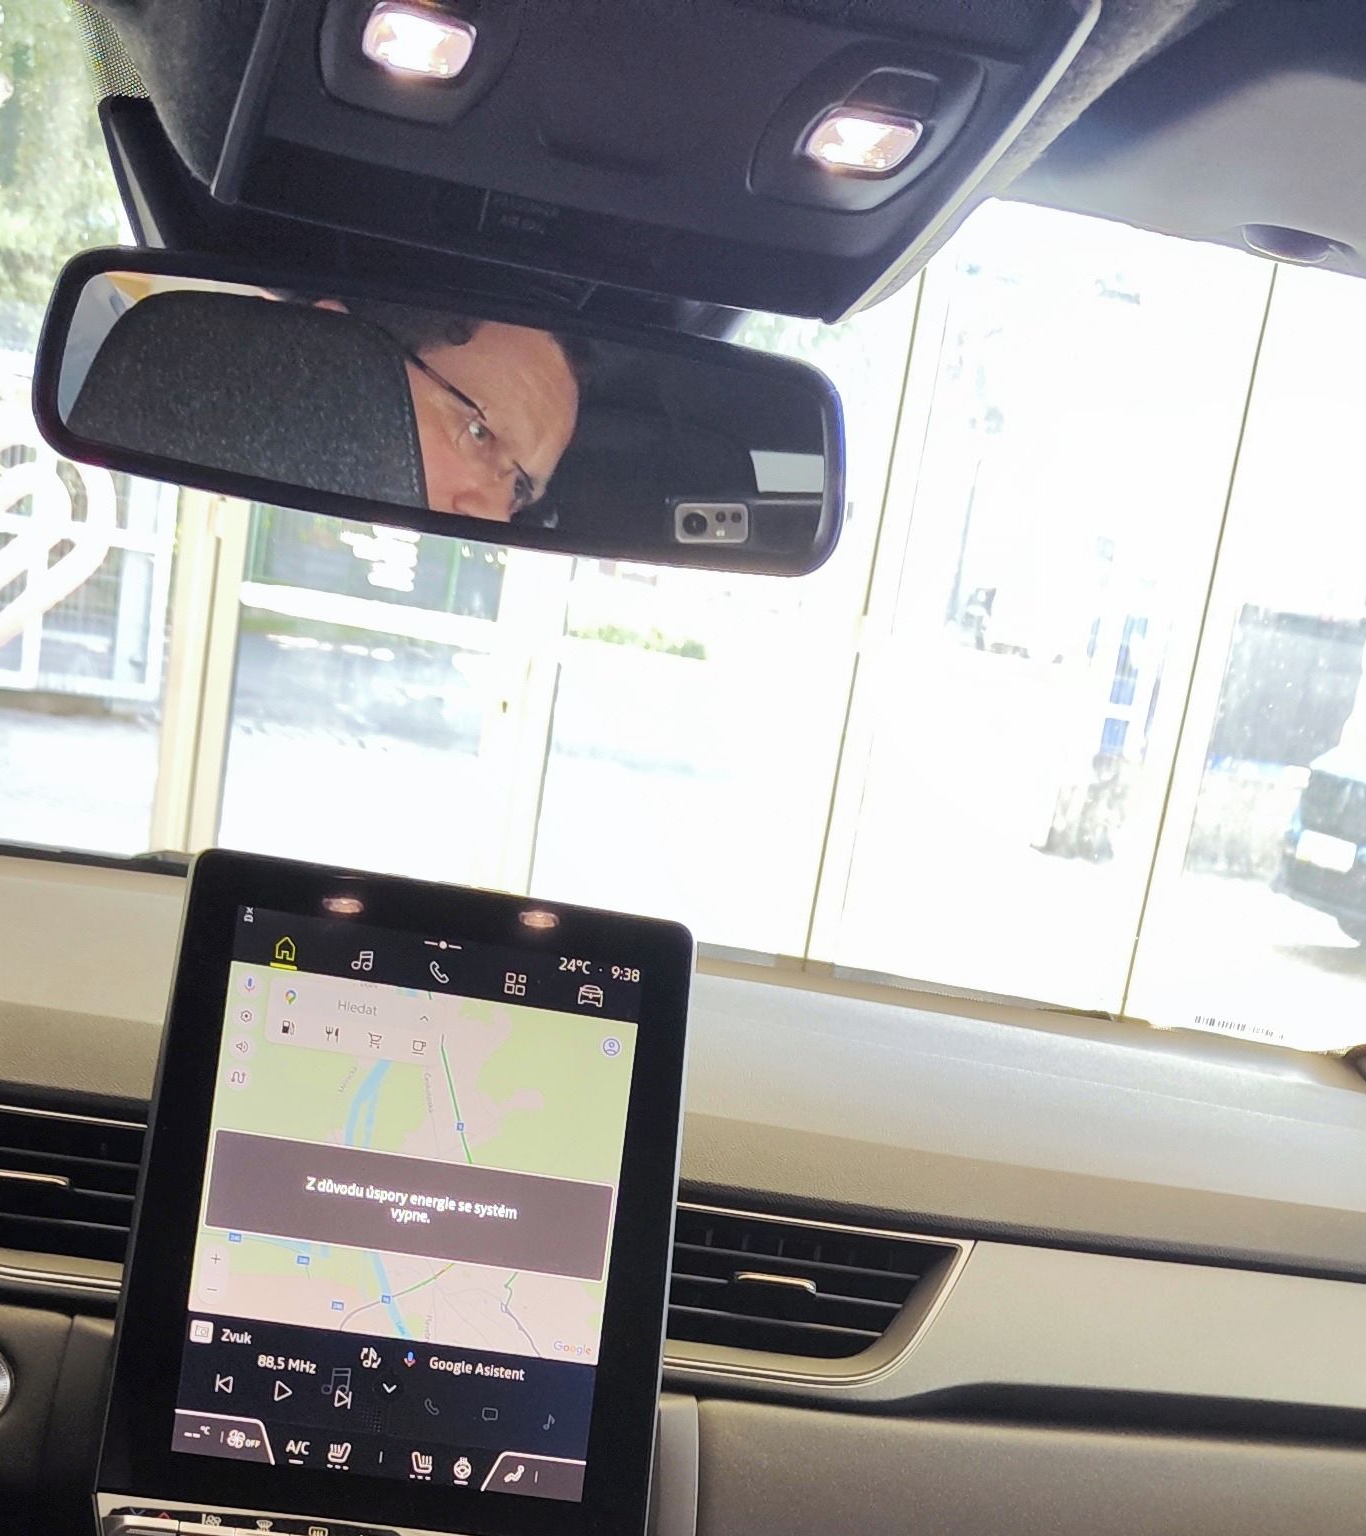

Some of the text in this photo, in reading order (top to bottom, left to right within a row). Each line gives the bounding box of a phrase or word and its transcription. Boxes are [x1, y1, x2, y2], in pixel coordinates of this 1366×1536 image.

[558, 957, 640, 982] 24°C 9:38
[337, 1000, 378, 1016] Hledat
[305, 1176, 518, 1220] Z důvodu úspory energie se systém
[390, 1206, 431, 1224] vypne.
[220, 1328, 252, 1345] Zvuk
[553, 1340, 593, 1355] Google
[257, 1354, 317, 1375] 88,5 MHz
[429, 1356, 526, 1381] Google Asistent
[245, 1438, 262, 1449] OFF
[285, 1438, 311, 1456] A/C
